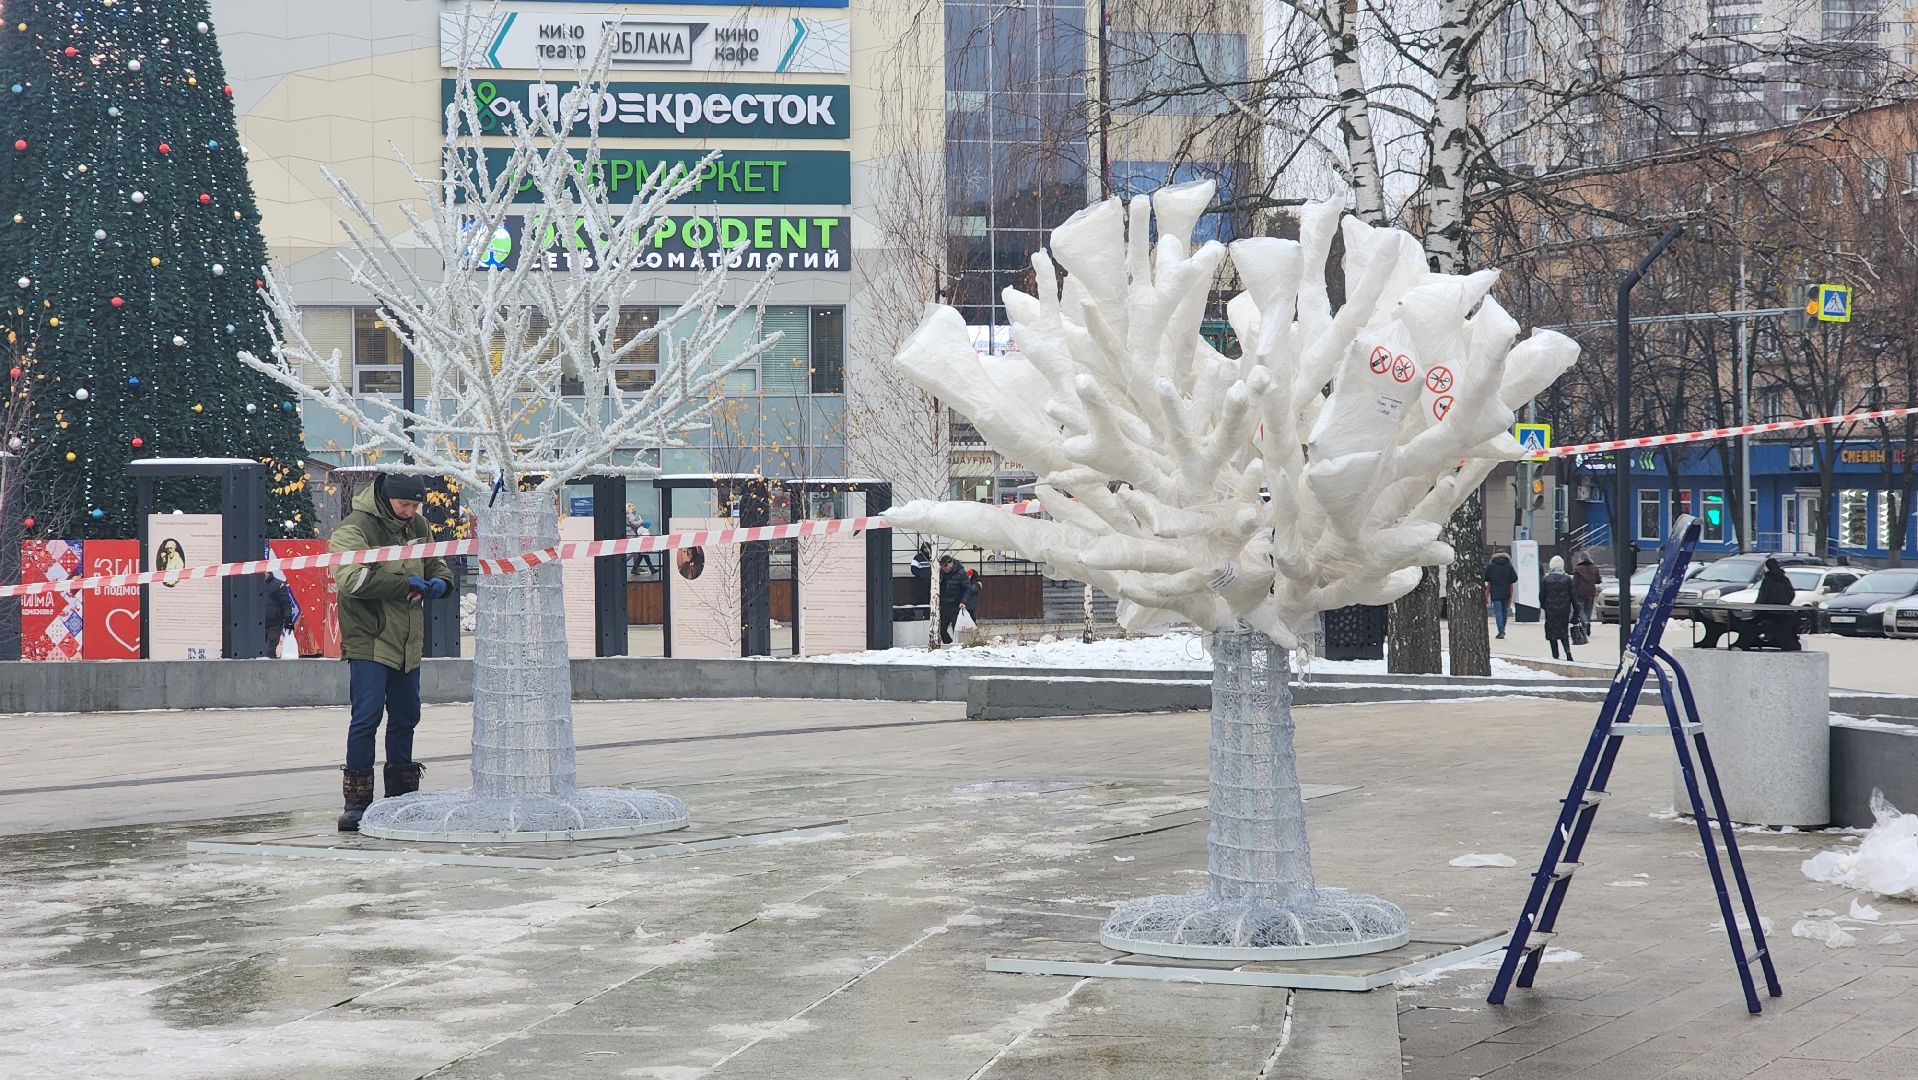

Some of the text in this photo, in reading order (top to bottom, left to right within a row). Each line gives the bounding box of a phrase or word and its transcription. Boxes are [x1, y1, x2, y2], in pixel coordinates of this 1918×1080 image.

[715, 27, 759, 42] кино
[715, 43, 760, 65] кафе
[508, 159, 787, 192] ЕРМАРКЕТ
[610, 250, 839, 268] ОМАТОЛОГИЙ
[1004, 461, 1024, 470] ГРИ
[21, 592, 55, 607] ИМА
